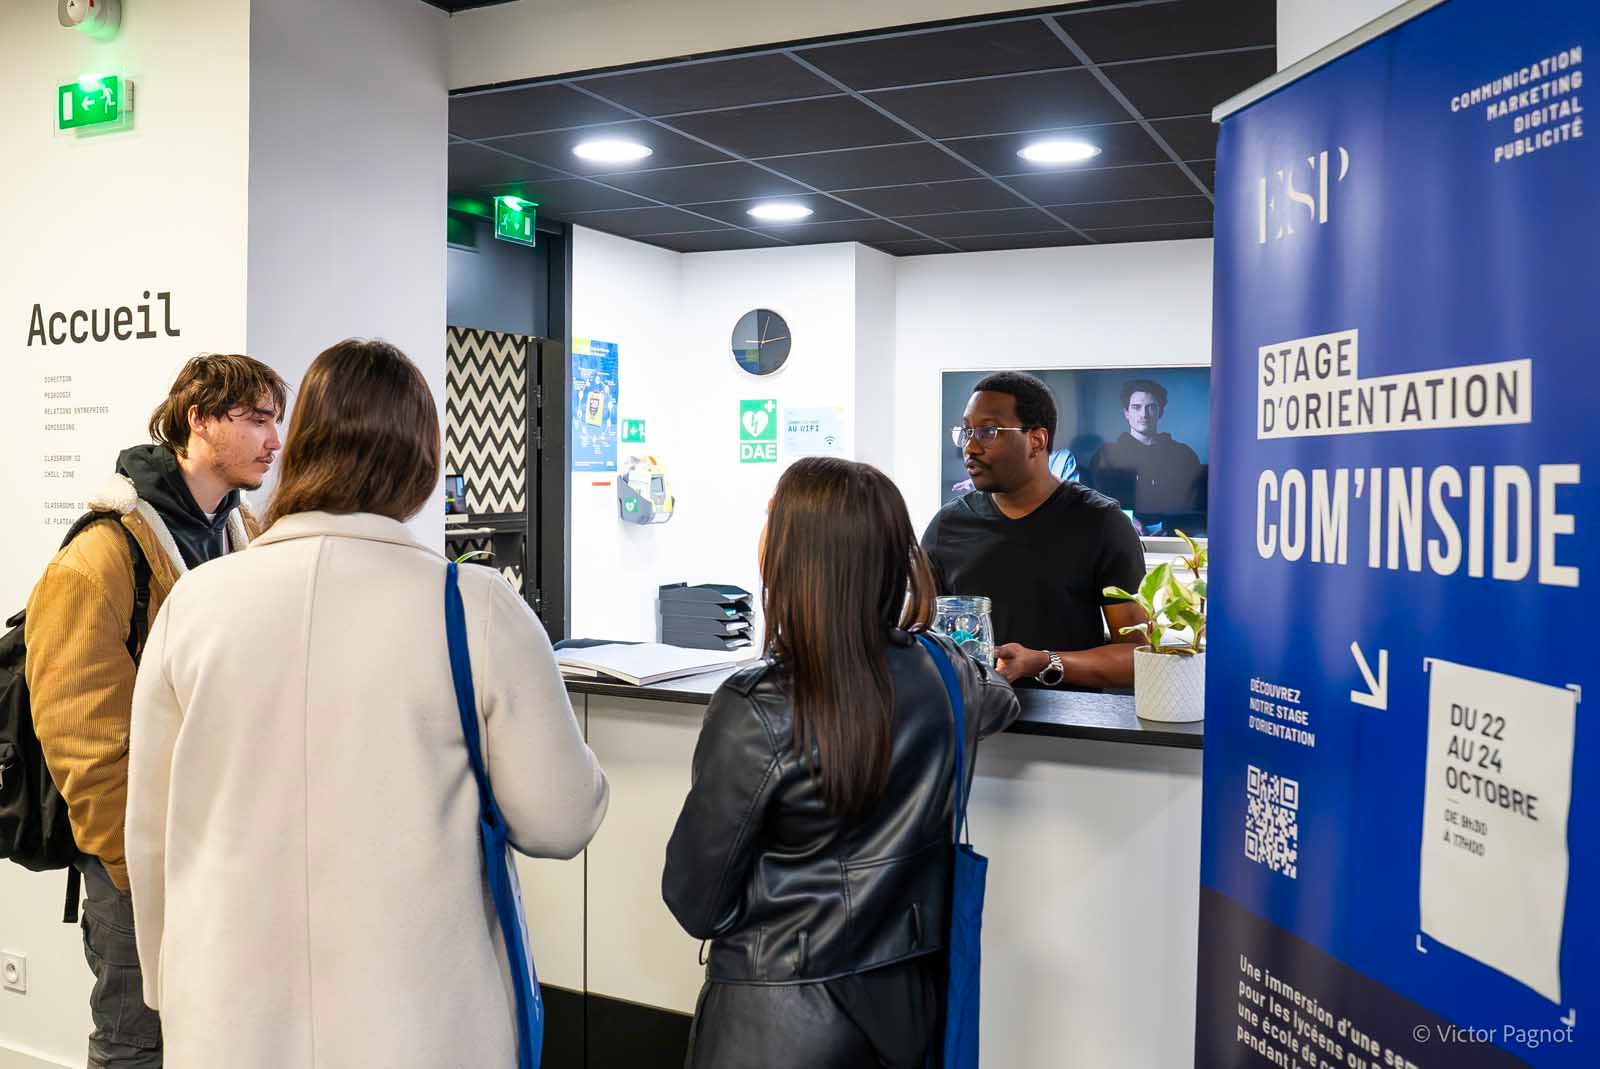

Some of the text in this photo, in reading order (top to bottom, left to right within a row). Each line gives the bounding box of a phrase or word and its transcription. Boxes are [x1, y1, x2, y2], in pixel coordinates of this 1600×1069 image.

[1451, 46, 1583, 112] COMMUNICATION
[1486, 70, 1583, 121] MARKETING
[1513, 95, 1583, 134] DIGITAL
[1493, 117, 1584, 164] PUBLICITÉ
[1259, 146, 1349, 244] ESP
[27, 290, 181, 346] Accueil
[1263, 338, 1353, 386] STAGE
[1263, 370, 1519, 433] D'ORIENTATION
[741, 444, 777, 459] DAE
[1256, 463, 1581, 588] COM'INSIDE
[1249, 697, 1309, 726] NOTRE STAGE
[1250, 677, 1301, 704] DÉCOUVREZ
[1248, 715, 1316, 748] D'ORIENTATION
[1450, 703, 1506, 741] DU 22
[1447, 735, 1503, 773] AU 24
[1444, 808, 1459, 825] DE
[1445, 766, 1539, 821] OCTOBRE
[1238, 980, 1267, 1008] pour
[1269, 995, 1291, 1023] les
[1293, 1009, 1344, 1061] lycéens
[1239, 953, 1262, 982] Une
[1264, 969, 1334, 1029] immersion
[1337, 1017, 1381, 1058] d'une
[1236, 1024, 1288, 1069] pendant
[1238, 1002, 1259, 1028] une
[1262, 1016, 1299, 1054] école
[1301, 1044, 1317, 1068] de
